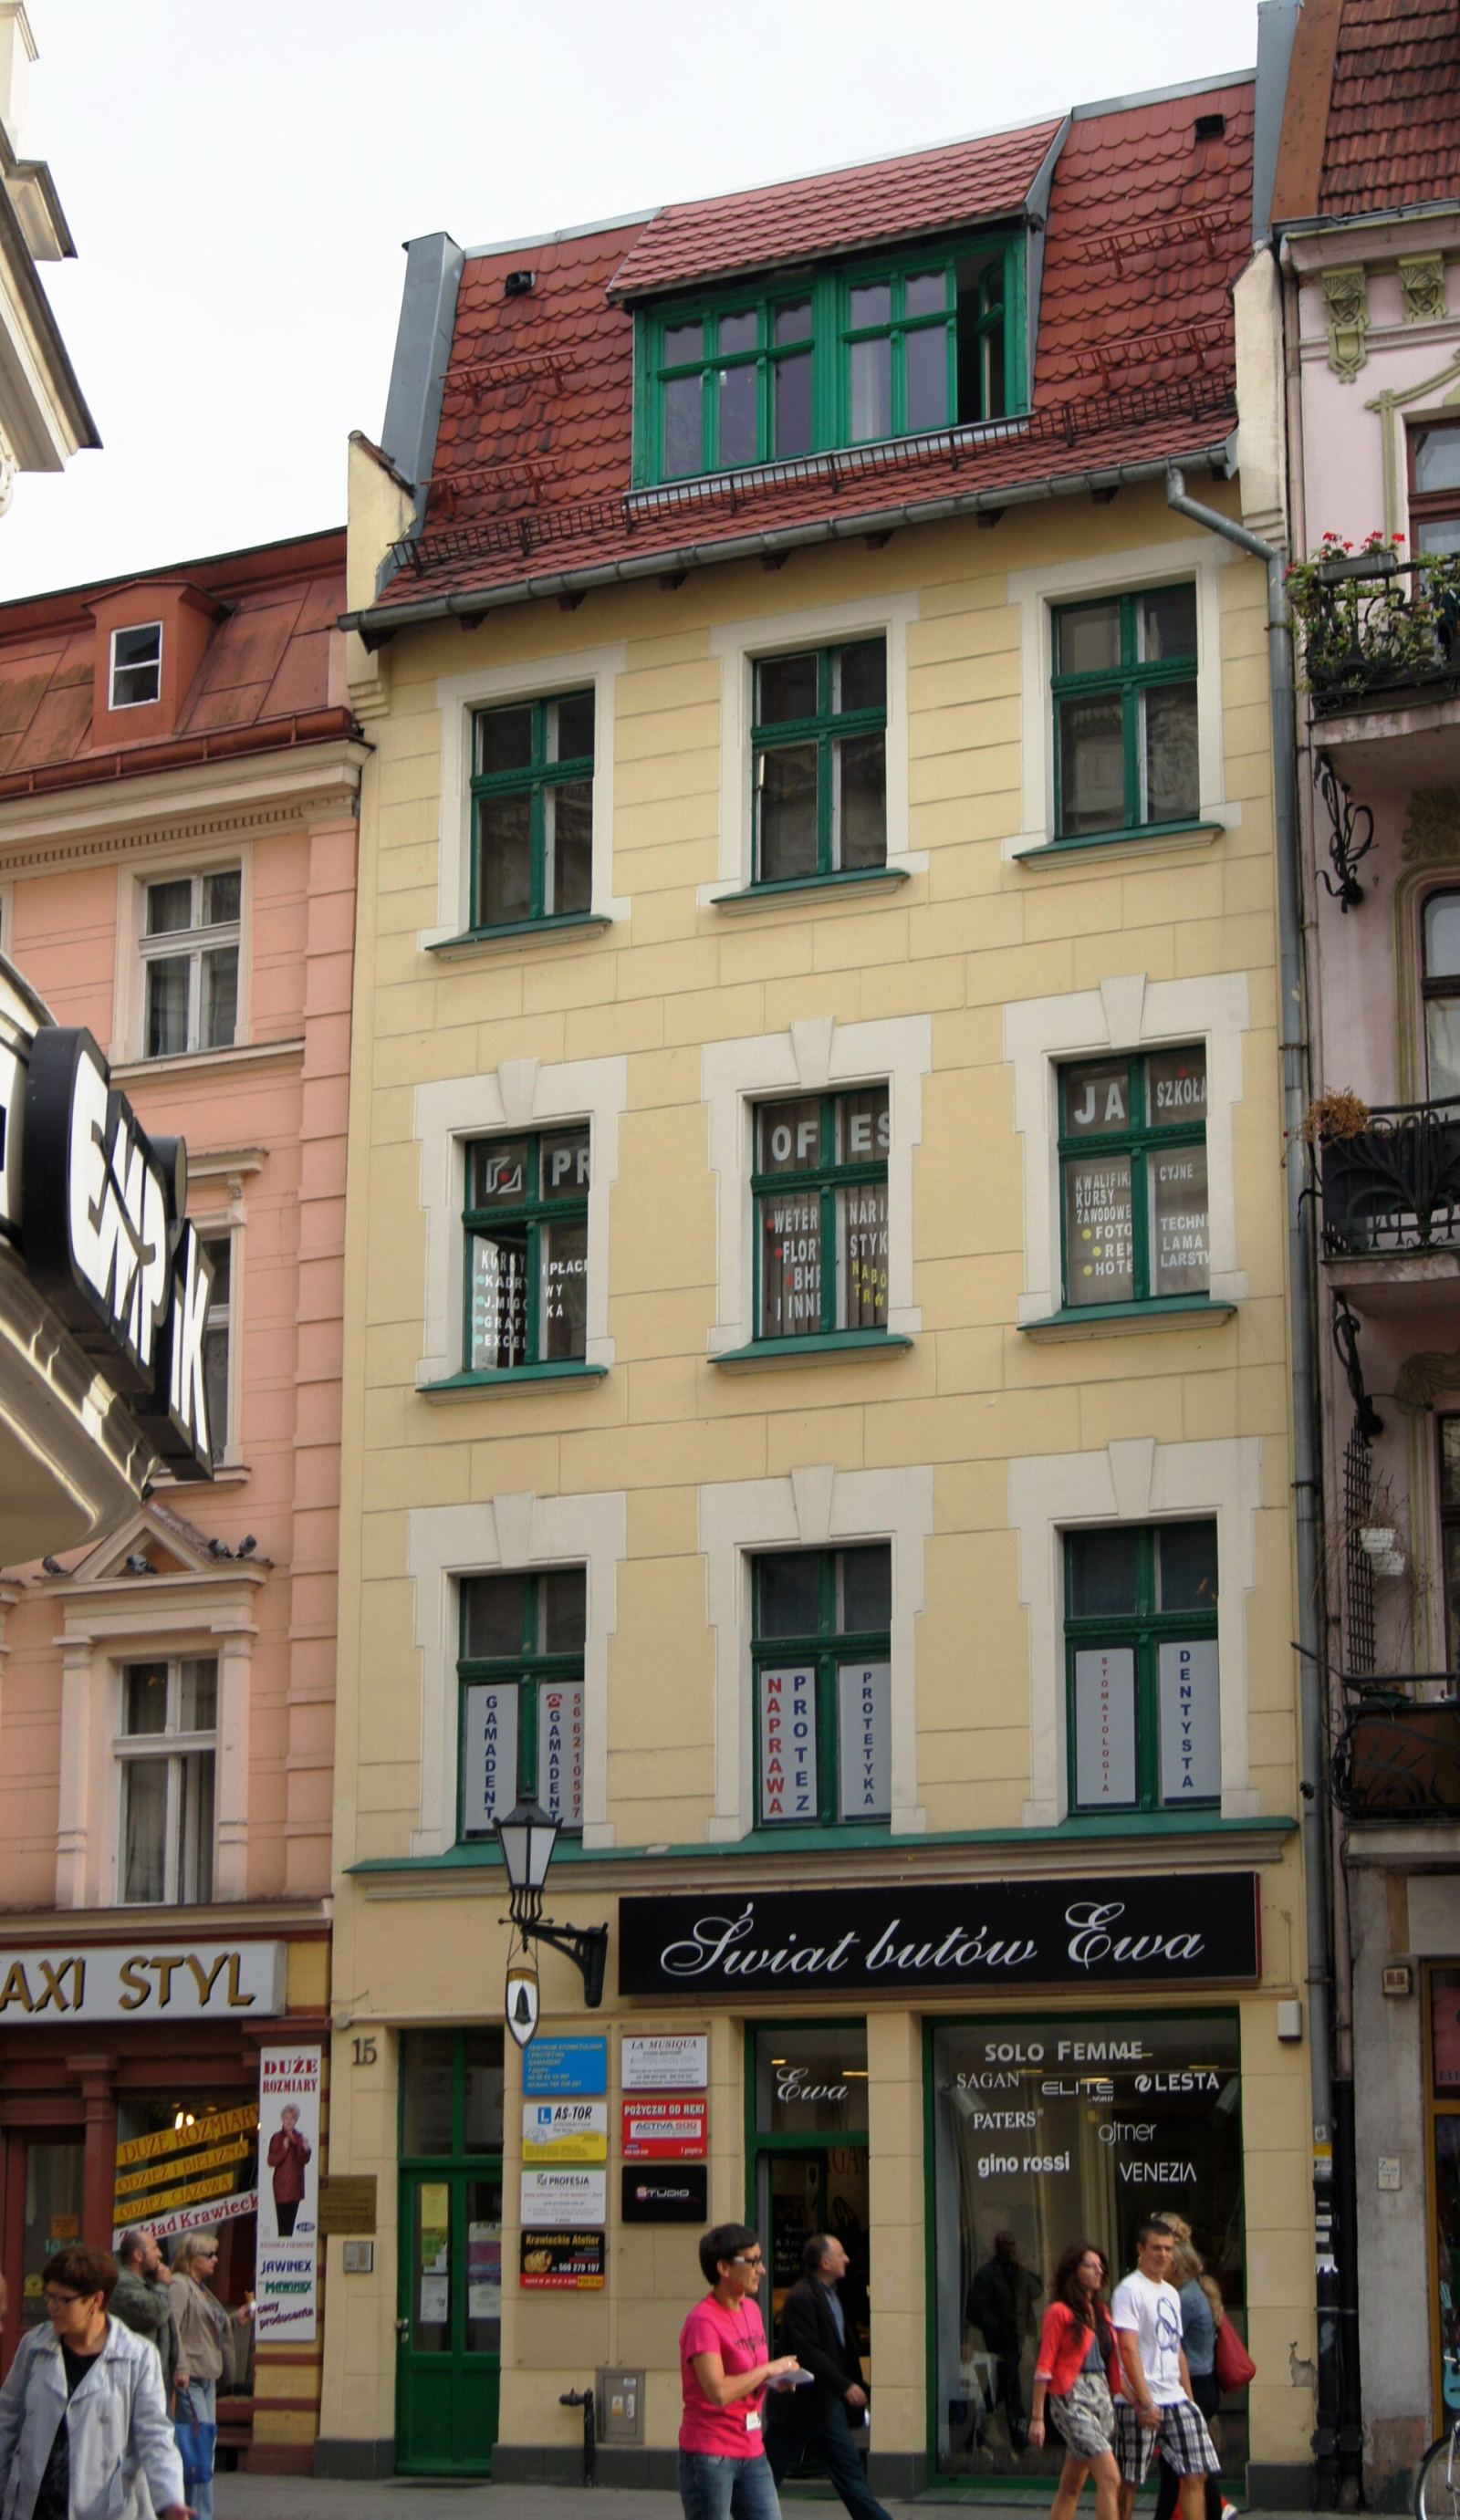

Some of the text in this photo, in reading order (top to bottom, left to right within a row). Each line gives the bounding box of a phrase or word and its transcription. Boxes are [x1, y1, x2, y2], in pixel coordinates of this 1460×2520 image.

[1074, 1082, 1126, 1124] JA
[771, 1121, 818, 1161] OF
[1076, 1171, 1131, 1192] KWALIFIK
[850, 1199, 889, 1225] NARI
[1076, 1189, 1114, 1208] KURSY
[783, 1237, 820, 1265] FLOR
[1100, 1658, 1109, 1792] STOMATOLOGIA
[1180, 1650, 1194, 1788] DENTYSTA
[766, 1678, 785, 1814] NAPRAWA
[793, 1676, 809, 1811] PROTEZ
[862, 1672, 875, 1805] PROTETYKA
[484, 1695, 497, 1819] GAMADENT
[661, 1902, 1206, 1976] Świat butów Ewa
[119, 1951, 256, 2011] STYL
[263, 2056, 318, 2075] DUŻE
[352, 2036, 378, 2067] 15
[985, 2043, 1044, 2062] SOLO
[263, 2078, 318, 2094] ROZMIARY
[777, 2067, 849, 2104] Ewa
[957, 2071, 1020, 2089] SAGAN
[1041, 2080, 1114, 2096] ELITE
[1154, 2072, 1220, 2091] LESTA
[625, 2103, 666, 2116] POŻYCZKI
[669, 2104, 681, 2115] OD
[978, 2151, 1070, 2178] gino rossi
[1120, 2161, 1197, 2182] VENEZIA
